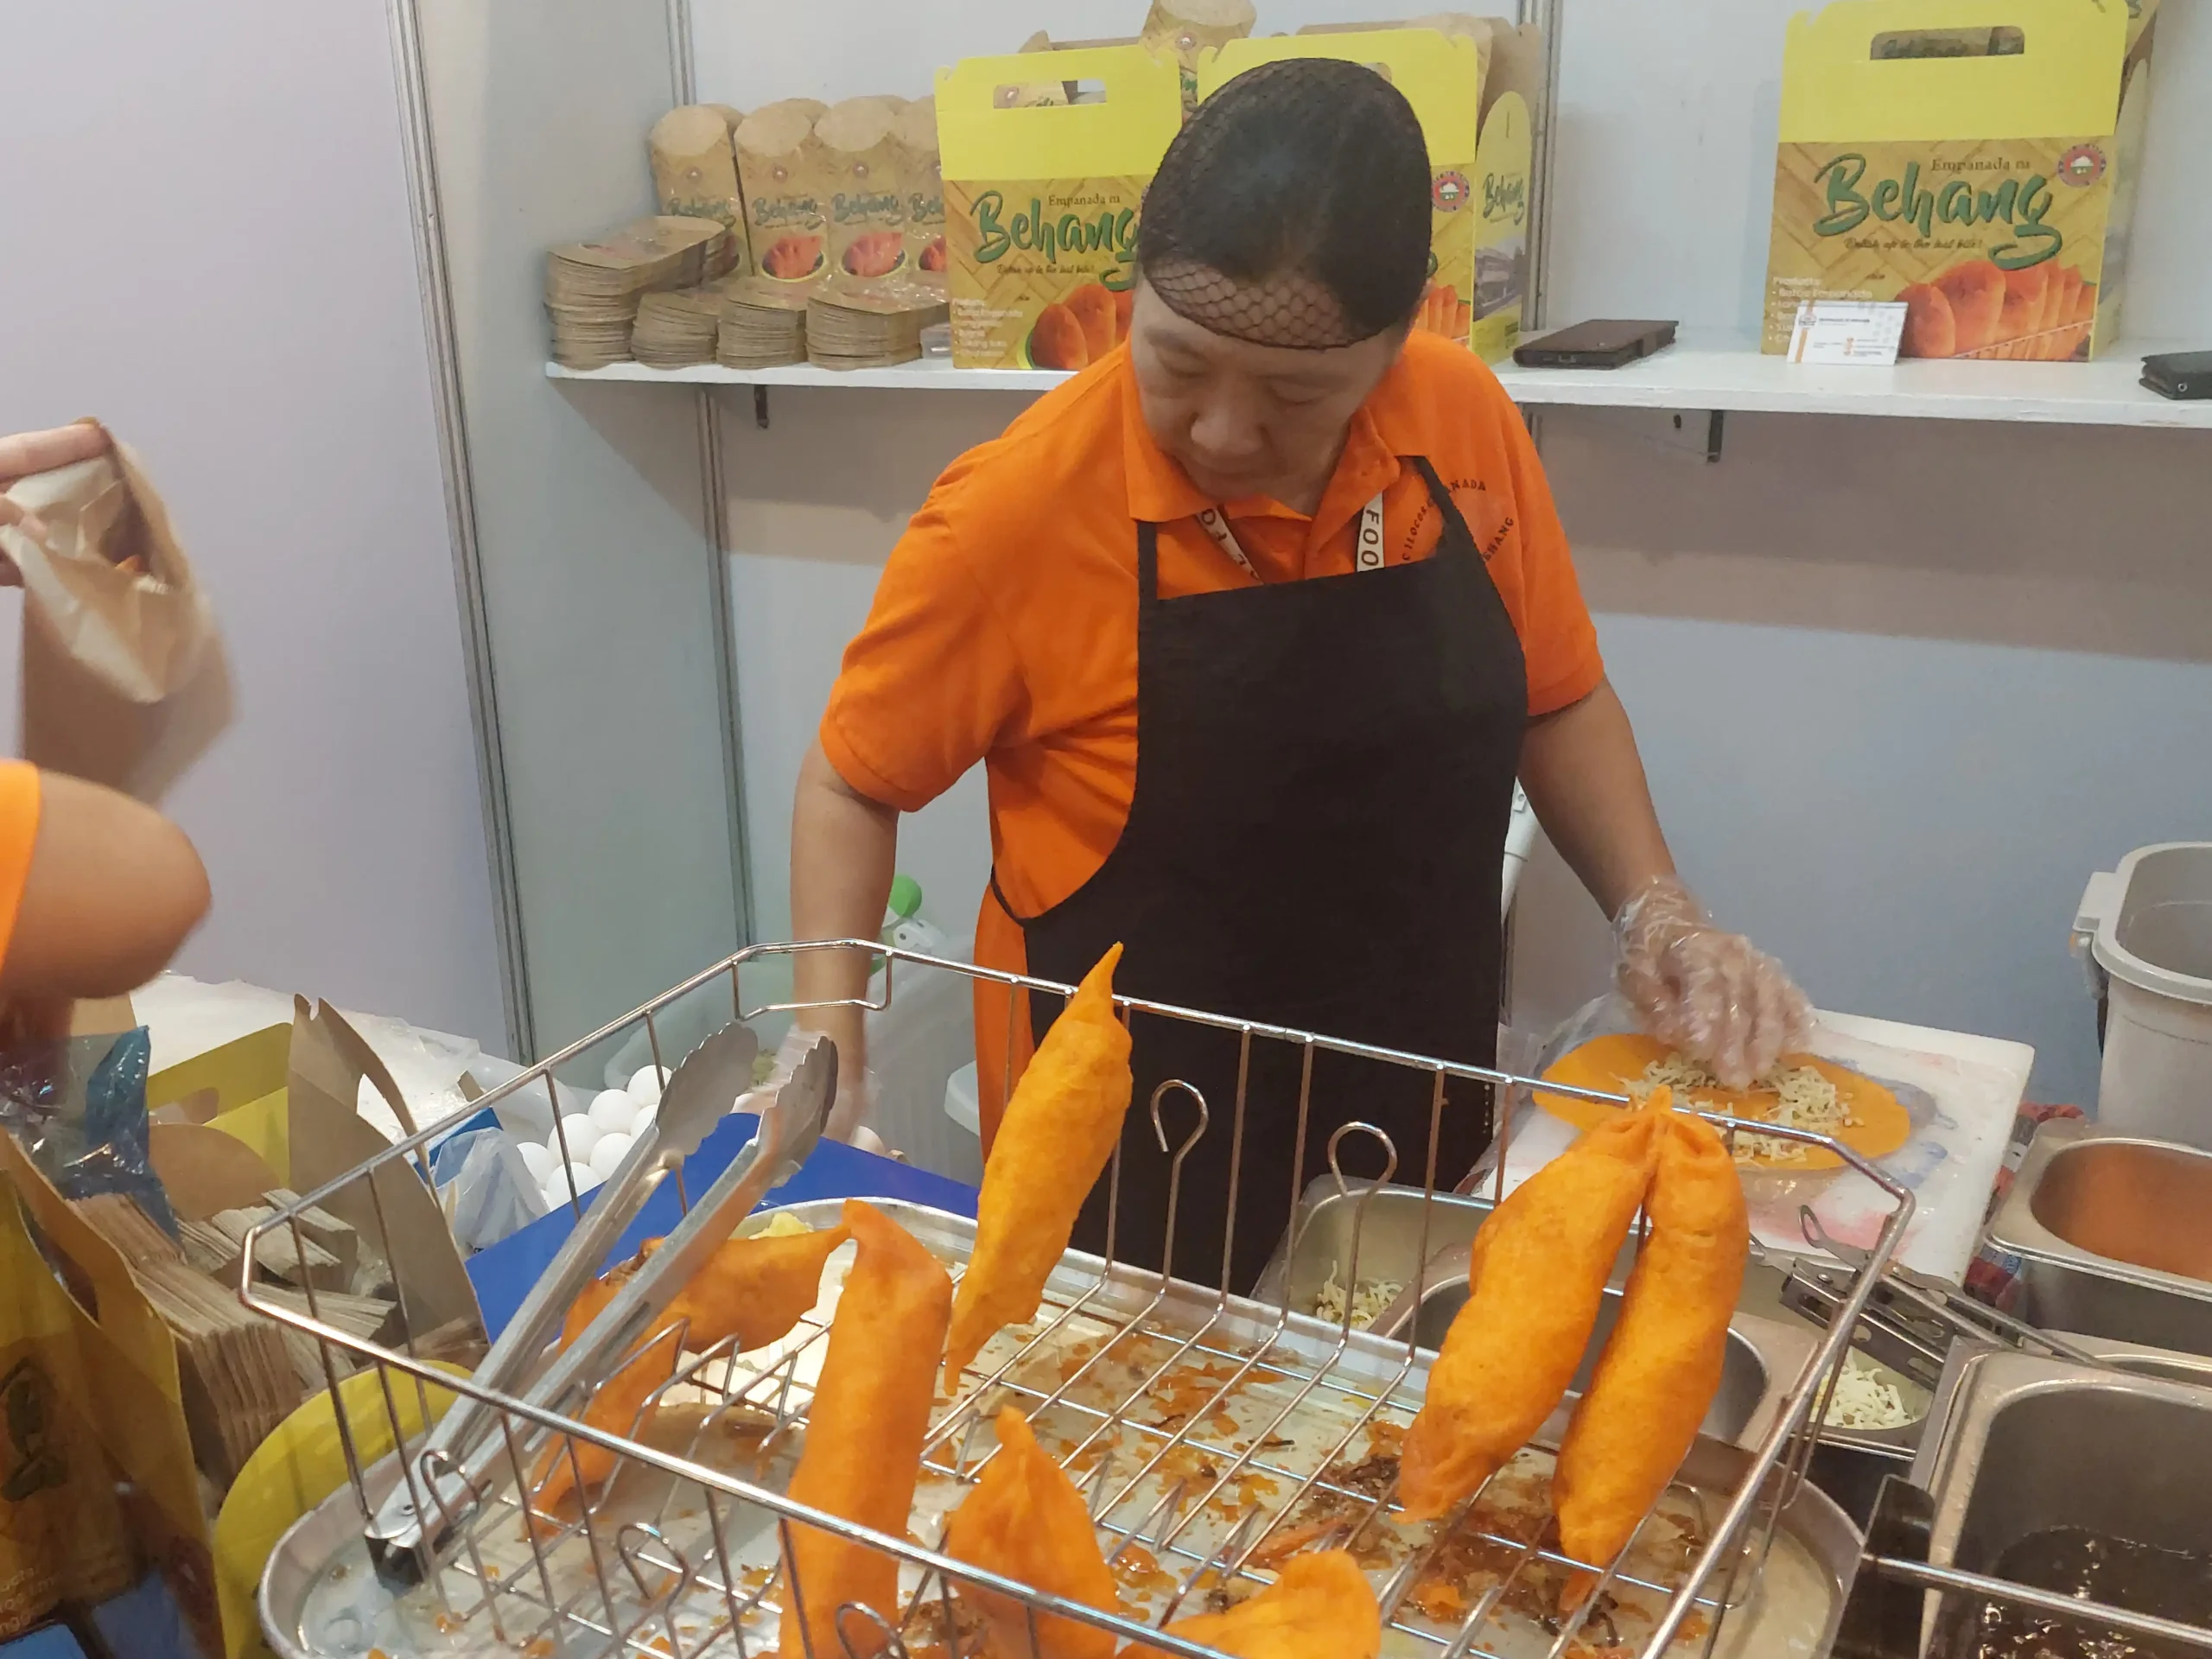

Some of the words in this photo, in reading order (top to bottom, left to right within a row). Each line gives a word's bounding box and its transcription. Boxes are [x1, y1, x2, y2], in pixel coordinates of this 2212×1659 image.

[1931, 156, 2010, 175] Empanada
[1048, 193, 1105, 208] Empanada
[1482, 173, 1525, 226] Behang
[1813, 152, 2063, 271] Behang
[969, 189, 1139, 293] Behang
